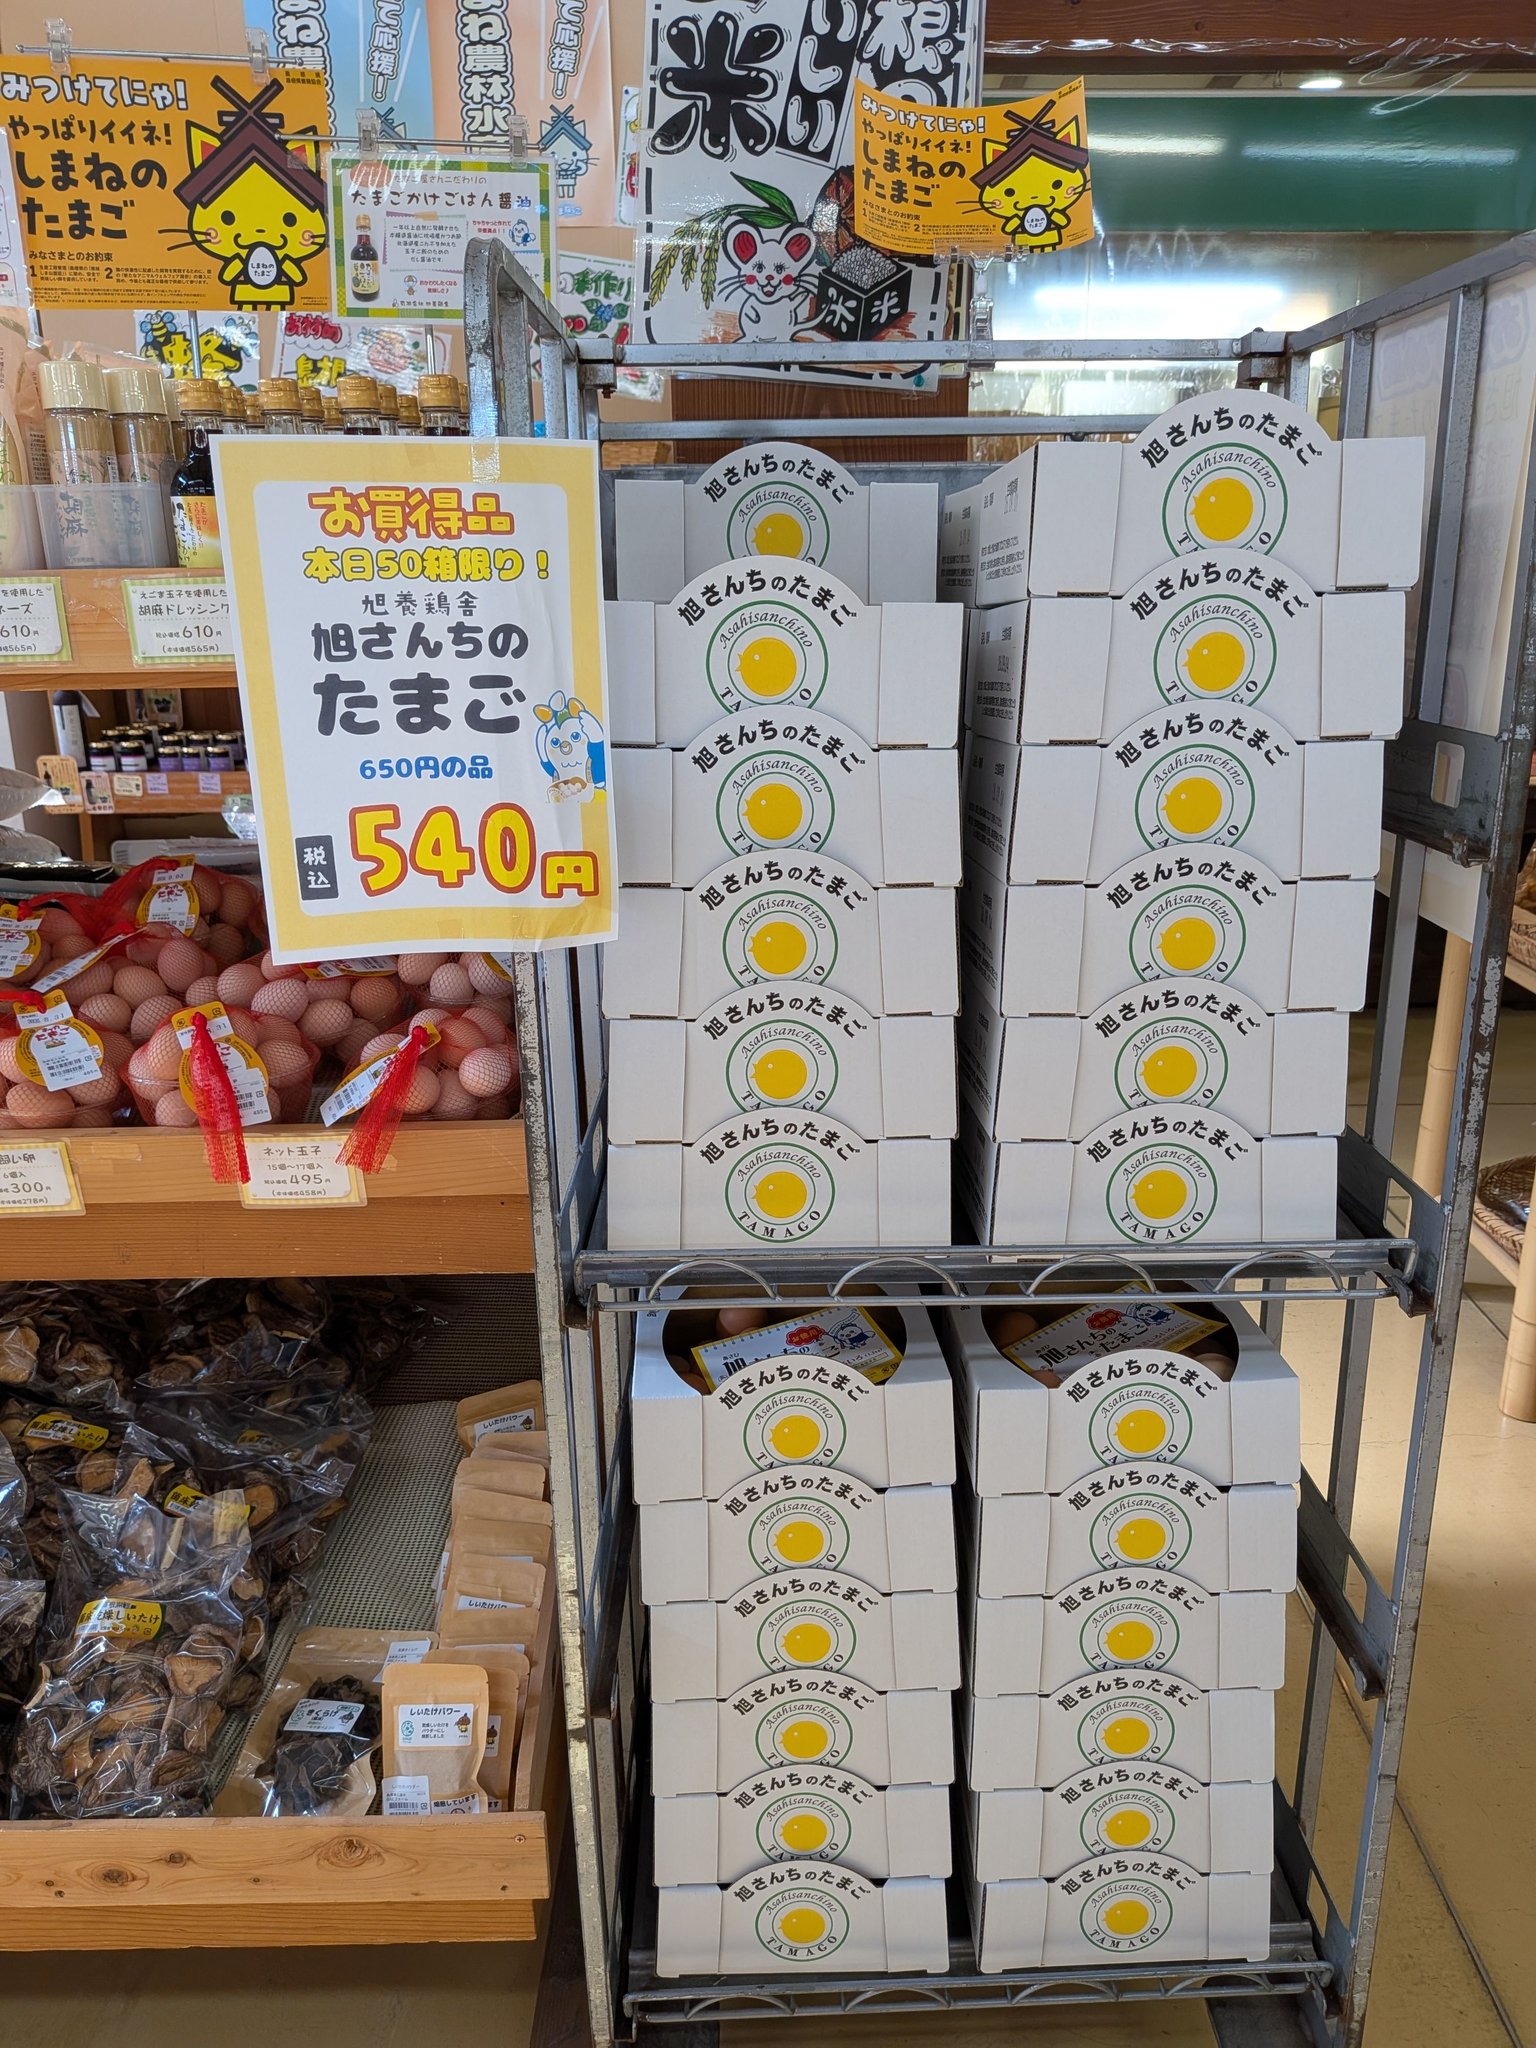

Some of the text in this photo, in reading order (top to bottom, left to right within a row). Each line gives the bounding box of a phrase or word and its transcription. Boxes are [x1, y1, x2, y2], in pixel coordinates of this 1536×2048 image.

[2, 73, 189, 110] みつけてにゃ!
[459, 0, 515, 153] ね農林水
[652, 10, 779, 159] 米
[8, 115, 174, 146] やっぱりイイネ!
[861, 93, 986, 134] みつけてにゃ!
[862, 118, 972, 154] やっぱりイイネ!
[15, 149, 168, 191] しまねの
[862, 139, 966, 179] しまねの
[350, 190, 532, 210] たまごかけごはん醤油
[862, 167, 940, 208] たまご
[22, 198, 136, 241] たまご
[862, 199, 920, 221] みなさまとのお約束
[29, 250, 113, 262] みなさまとのお約束
[104, 267, 113, 280] 2
[821, 287, 857, 333] 米
[870, 291, 901, 324] 米
[284, 312, 343, 344] おすすめ
[1141, 406, 1322, 469] 旭さんちのたまご
[703, 453, 854, 504] 旭さんちのたまご
[1180, 450, 1277, 493] Asahisanchino
[308, 486, 515, 543] お買得品
[738, 489, 817, 522] Asahisanchino
[303, 546, 549, 583] 本日50箱限り！
[1, 588, 44, 597] を使用した
[140, 588, 227, 599] えごま玉子を使用した
[361, 591, 479, 617] 旭養鶏舎
[677, 568, 857, 627] 旭さんちのたまご
[1129, 560, 1309, 621] 旭さんちのたまご
[311, 621, 529, 663] 旭さんちの
[719, 612, 812, 649] Asahisanchino
[1168, 604, 1264, 644] Asahisanchino
[313, 672, 527, 736] たまご
[691, 719, 865, 774] 旭さんちのたまご
[1115, 712, 1290, 769] 旭さんちのたまご
[359, 755, 494, 781] 650円の品
[732, 758, 823, 795] Asahisanchino
[1153, 753, 1245, 790] Asahisanchino
[349, 802, 600, 897] 540円
[303, 846, 332, 890] 税込
[700, 860, 867, 911] 旭さんちのたまご
[1106, 857, 1276, 909] 旭さんちのたまご
[738, 898, 826, 932] Asahisanchino
[1144, 893, 1232, 928] Asahisanchino
[703, 991, 867, 1041] 旭さんちのたまご
[1095, 989, 1260, 1038] 旭さんちのたまご
[741, 1025, 827, 1059] Asahisanchino
[1132, 1023, 1218, 1057] Asahisanchino
[263, 1145, 322, 1157] ネット玉子
[700, 1118, 860, 1165] 旭さんちのたまご
[1086, 1115, 1248, 1163] 旭さんちのたまご
[737, 1149, 822, 1182] Asahisanchino
[1122, 1148, 1207, 1182] Asahisanchino
[737, 1210, 821, 1238] TAMAGO
[1120, 1211, 1204, 1240] TAMAGO
[719, 1365, 869, 1410] 旭さんちのたまご
[1067, 1358, 1217, 1403] 旭さんちのたまご
[755, 1395, 834, 1425] Asahisanchino
[1101, 1388, 1180, 1419] Asahisanchino
[724, 1475, 872, 1516] 旭さんちのたまご
[1068, 1470, 1217, 1511] 旭さんちのたまご
[759, 1502, 836, 1531] Asahisanchino
[1102, 1499, 1179, 1526] Asahisanchino
[734, 1578, 878, 1618] 旭さんちのたまご
[1058, 1576, 1205, 1614] 旭さんちのたまご
[768, 1604, 844, 1632] Asahisanchino
[1091, 1602, 1168, 1629] Asahisanchino
[409, 1707, 461, 1716] しいたけパワー
[732, 1678, 875, 1715] 旭さんちのたまご
[1057, 1677, 1199, 1711] 旭さんちのたまご
[306, 1708, 339, 1718] きくらげ
[765, 1702, 840, 1729] Asahisanchino
[1088, 1700, 1163, 1726] Asahisanchino
[734, 1772, 873, 1809] 旭さんちのたまご
[1060, 1768, 1199, 1804] 旭さんちのたまご
[766, 1795, 839, 1822] Asahisanchino
[1091, 1792, 1164, 1818] Asahisanchino
[734, 1868, 871, 1902] 旭さんちのたまご
[1061, 1859, 1196, 1895] 旭さんちのたまご
[765, 1890, 838, 1915] Asahisanchino
[1091, 1883, 1162, 1908] Asahisanchino
[766, 1935, 838, 1957] TAMAGO
[1090, 1926, 1161, 1949] TAMAGO
